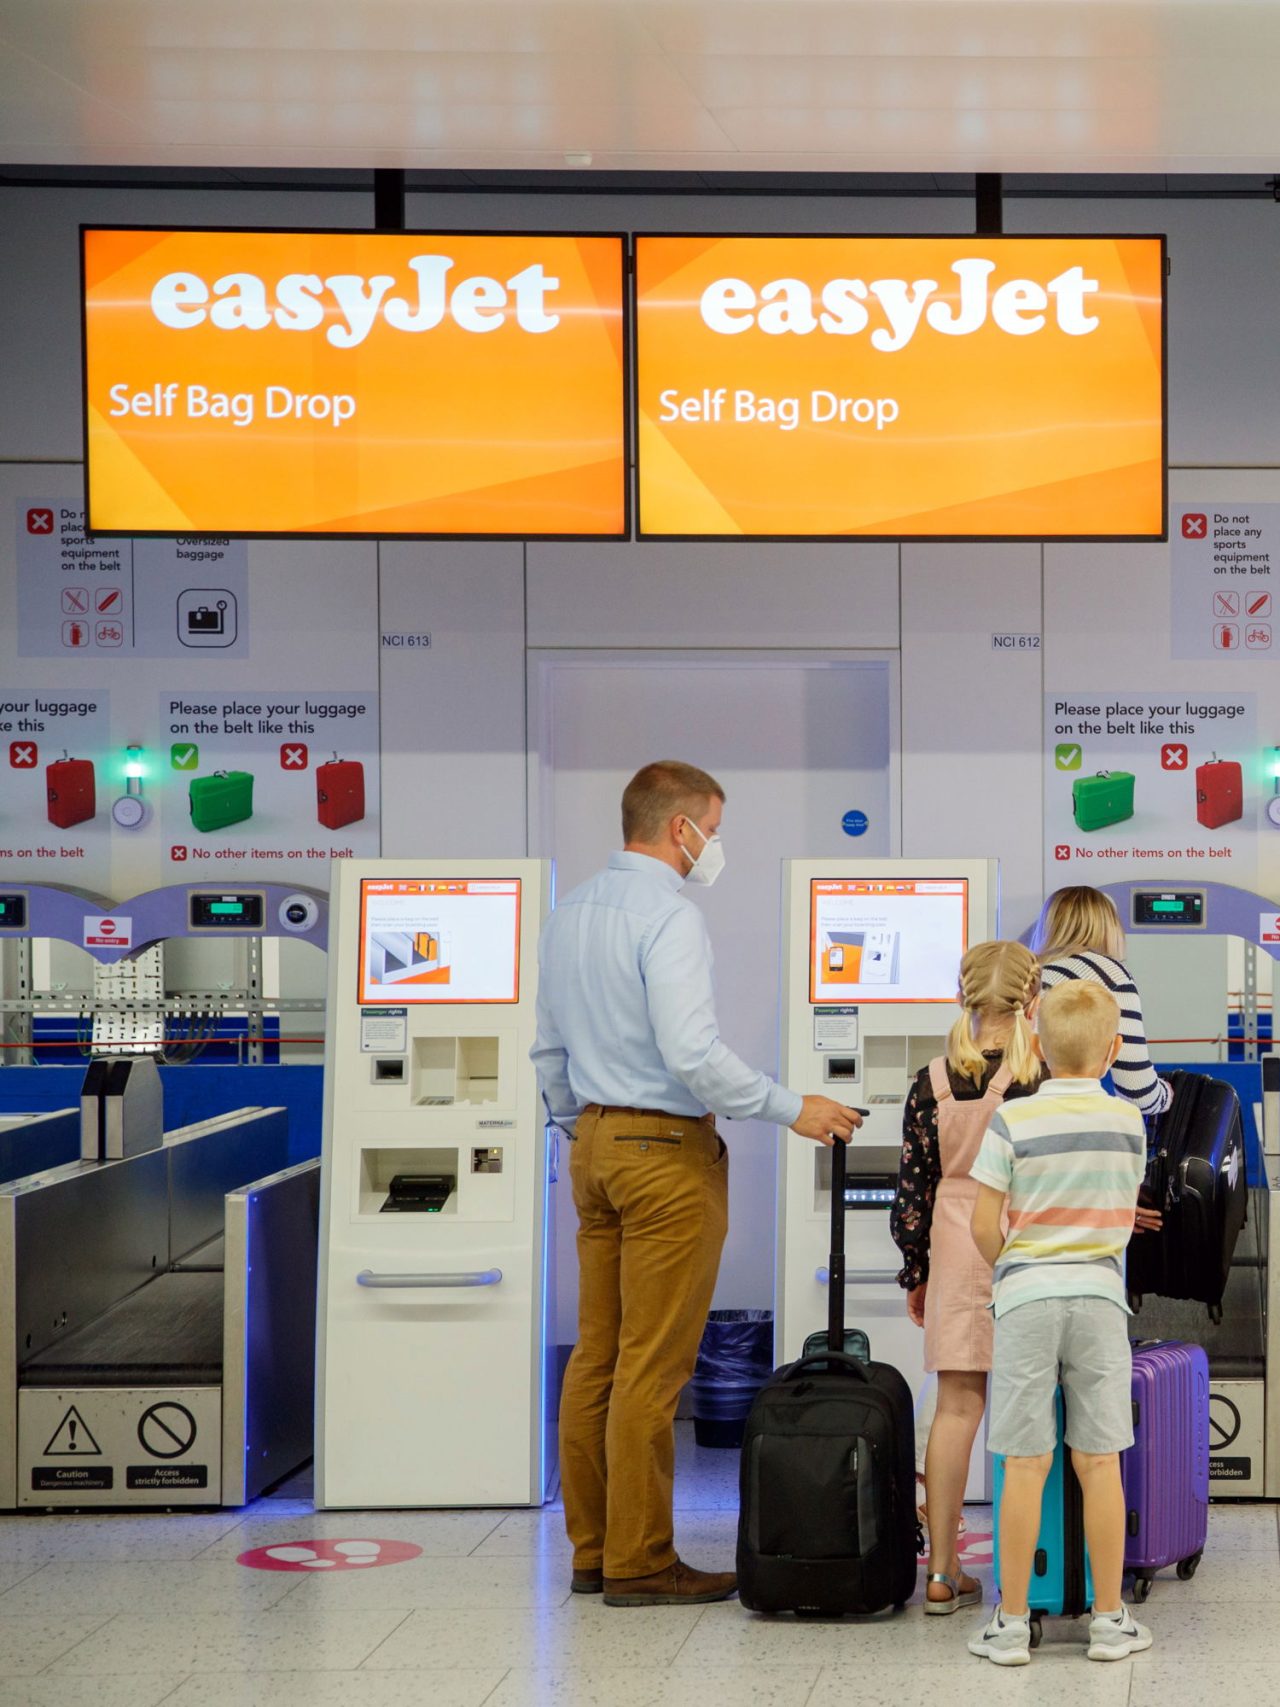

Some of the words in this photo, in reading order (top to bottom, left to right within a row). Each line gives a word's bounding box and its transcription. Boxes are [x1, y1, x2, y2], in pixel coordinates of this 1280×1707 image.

[149, 255, 560, 348] easyJet
[698, 258, 1099, 352] easyJet
[110, 384, 178, 416] Self
[188, 385, 254, 426] Bag
[266, 386, 356, 427] Drop
[660, 389, 726, 422] Self
[735, 390, 799, 430] Bag
[812, 391, 898, 430] Drop
[61, 509, 76, 518] Do
[1214, 514, 1229, 523] Do
[1214, 526, 1240, 538] place
[1244, 530, 1262, 538] any
[1214, 541, 1246, 551] sports
[61, 548, 119, 560] equipment
[177, 549, 224, 561] baggage
[1214, 552, 1269, 563] equipment
[78, 561, 96, 570] the
[100, 561, 120, 570] belt
[1230, 565, 1246, 574] the
[1250, 564, 1270, 574] belt
[382, 636, 403, 646] NCI
[408, 636, 429, 646] 613
[994, 636, 1014, 647] NCI
[1019, 637, 1040, 647] 612
[36, 699, 96, 716] luggage
[170, 701, 217, 714] Please
[223, 701, 262, 718] place
[267, 706, 300, 718] your
[306, 701, 366, 718] luggage
[1055, 702, 1100, 715] Please
[1106, 702, 1143, 718] place
[1149, 706, 1181, 718] your
[1186, 702, 1244, 718] luggage
[18, 718, 44, 731] this
[170, 724, 188, 733] on
[194, 720, 218, 733] the
[224, 720, 253, 733] belt
[259, 720, 283, 733] like
[288, 720, 314, 733] this
[1055, 725, 1072, 734] on
[1078, 721, 1101, 734] the
[1107, 721, 1135, 734] belt
[1140, 721, 1164, 734] like
[1169, 721, 1194, 734] this
[37, 847, 56, 857] the
[61, 847, 84, 857] belt
[193, 848, 210, 858] No
[215, 848, 246, 858] other
[252, 848, 283, 858] items
[306, 848, 326, 858] the
[330, 848, 353, 858] belt
[1076, 848, 1093, 858] No
[1097, 848, 1128, 857] other
[1133, 849, 1163, 857] items
[1186, 848, 1204, 857] the
[1209, 847, 1231, 857] belt
[56, 1470, 88, 1478] Caution
[1209, 1468, 1243, 1476] orbidden
[135, 1478, 160, 1486] strictly
